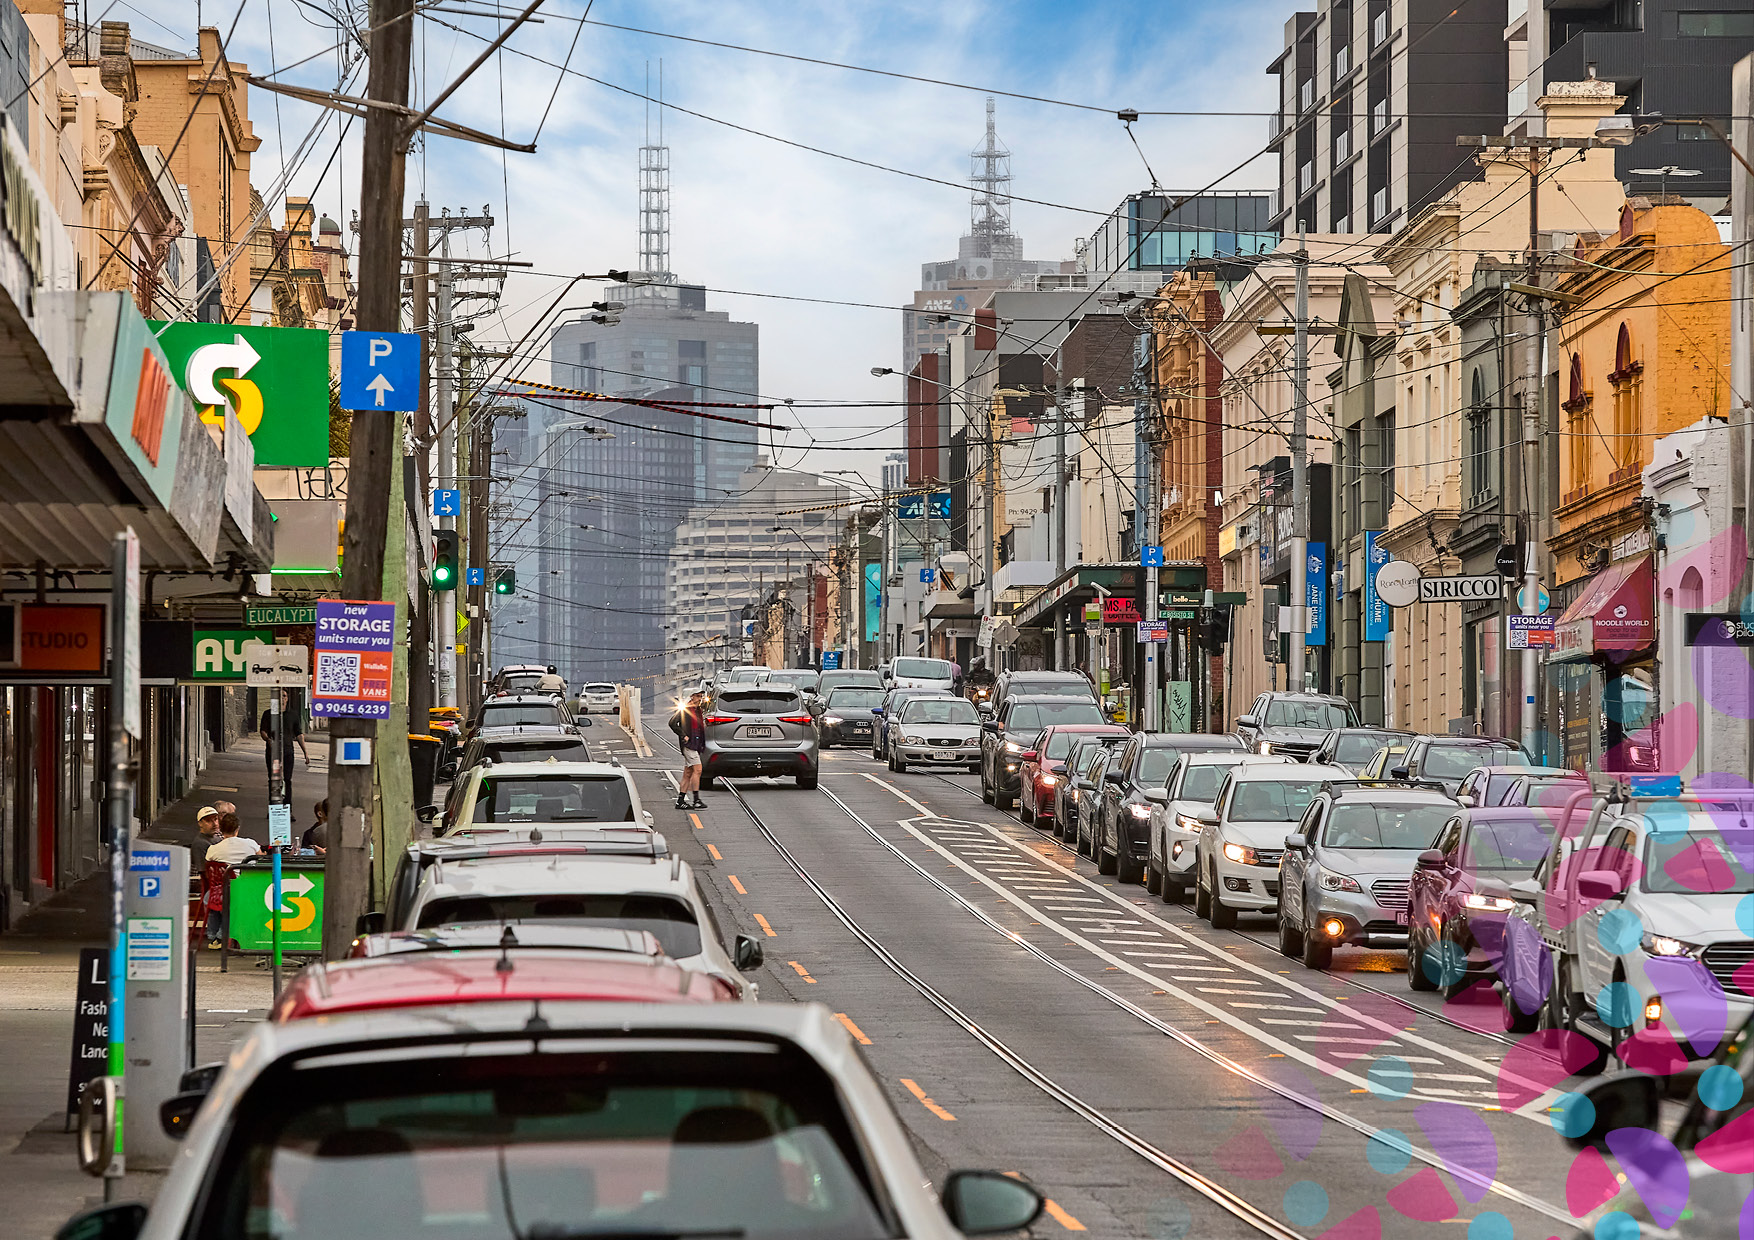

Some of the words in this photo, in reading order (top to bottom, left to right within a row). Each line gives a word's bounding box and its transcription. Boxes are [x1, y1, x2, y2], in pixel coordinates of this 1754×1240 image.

[922, 300, 952, 310] ANZ
[370, 339, 392, 366] P
[442, 492, 451, 501] P
[1148, 548, 1156, 556] P
[1423, 579, 1497, 598] SIRICCO
[344, 607, 368, 615] new
[1104, 600, 1122, 612] MS.
[319, 618, 391, 632] STORAGE
[1511, 617, 1552, 625] STORAGE
[319, 634, 344, 644] units
[346, 636, 369, 644] near
[372, 638, 390, 646] you
[363, 680, 386, 689] FREE
[326, 703, 354, 713] 9045
[358, 705, 387, 714] 6239
[130, 856, 169, 866] BRM014
[142, 878, 158, 896] P
